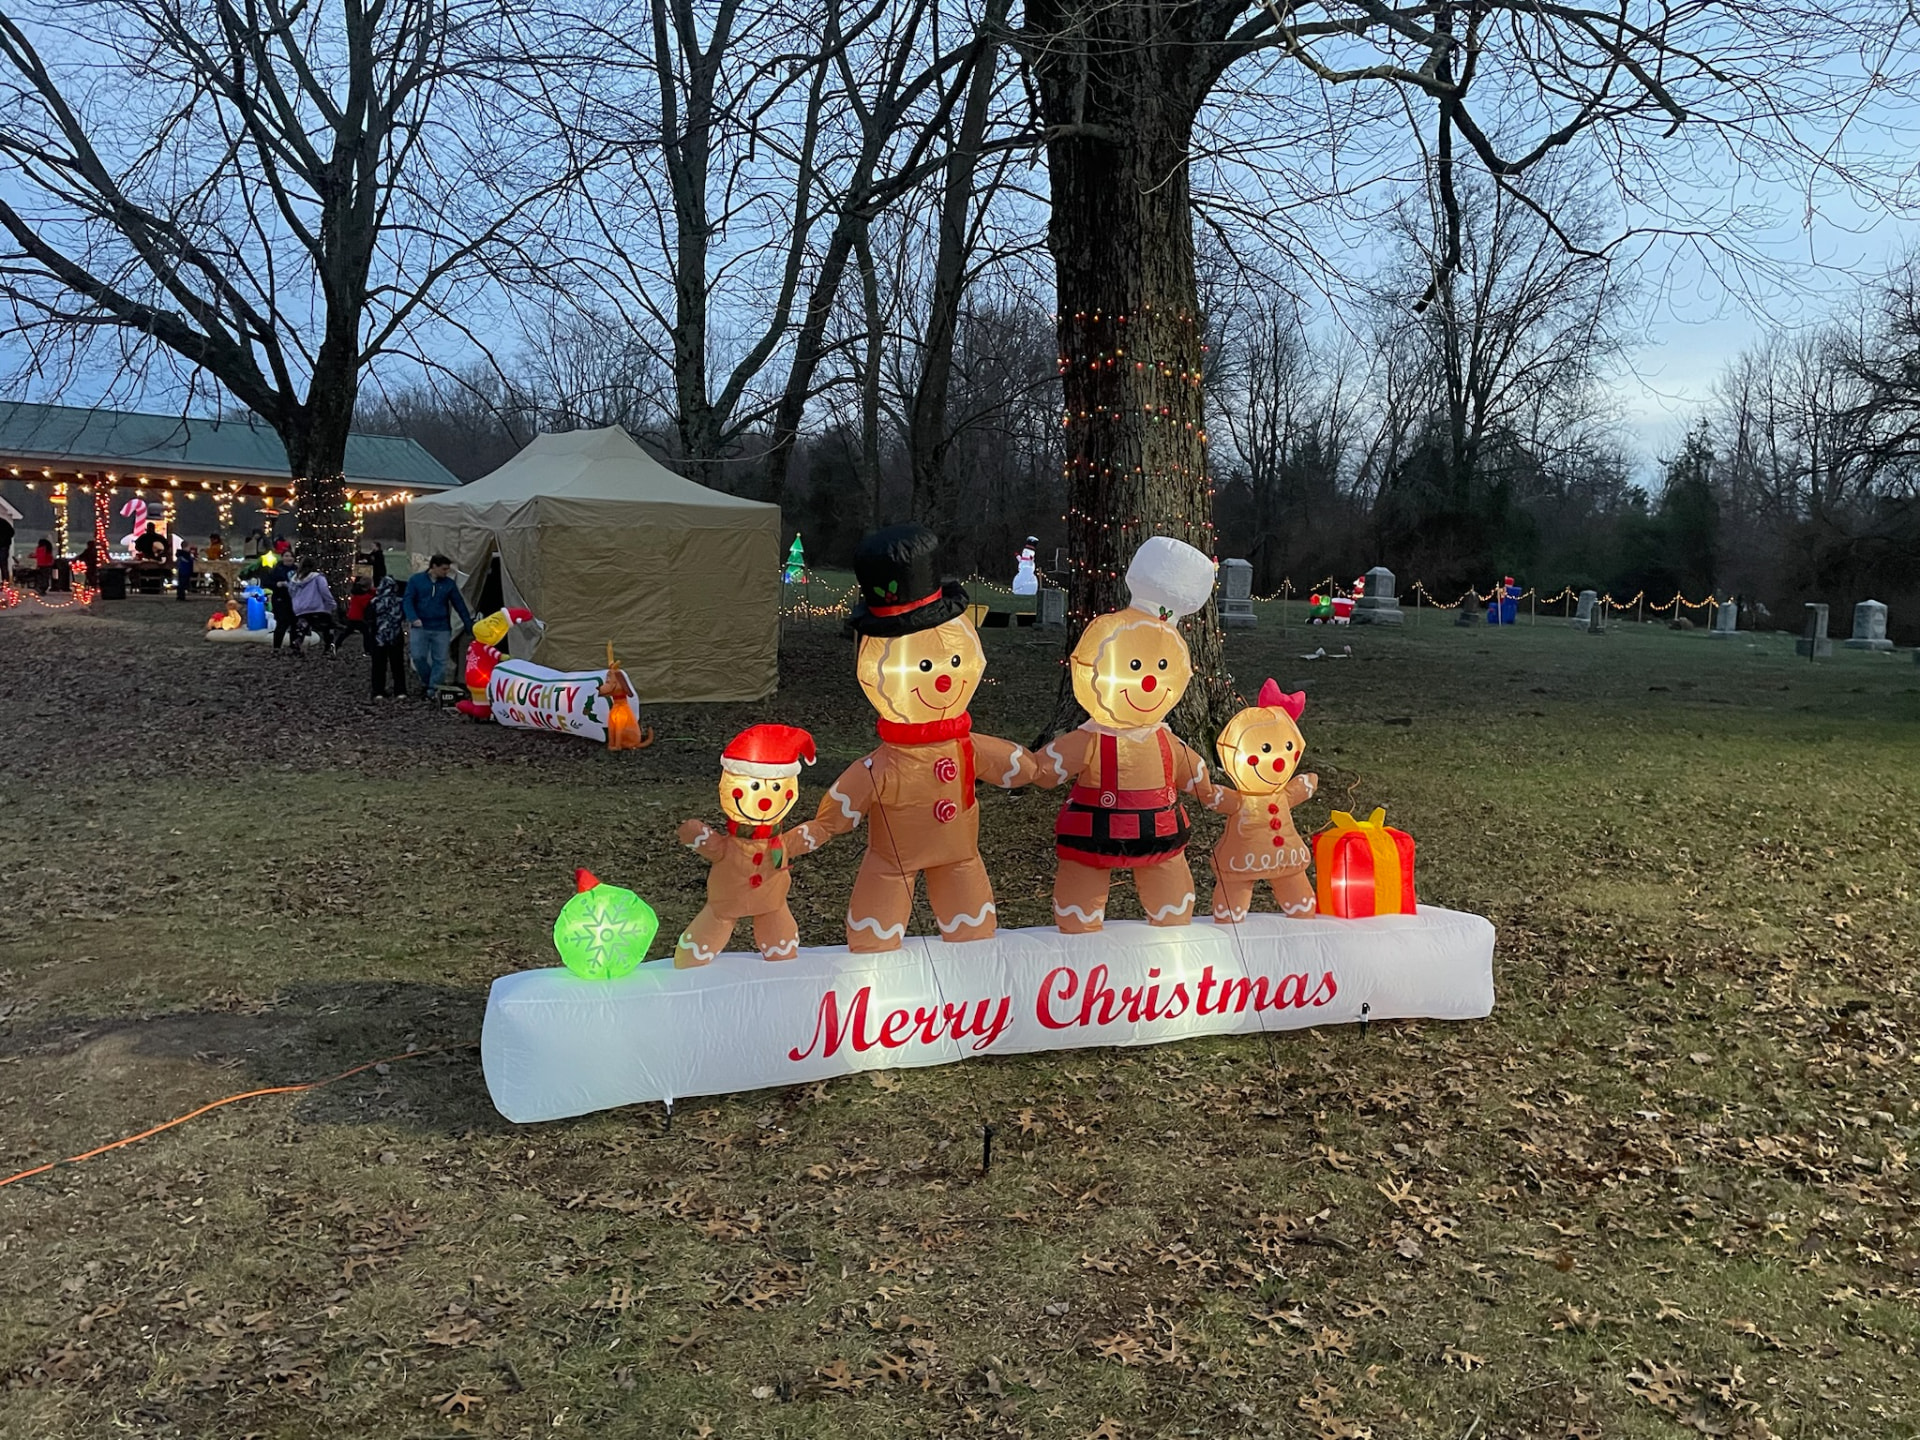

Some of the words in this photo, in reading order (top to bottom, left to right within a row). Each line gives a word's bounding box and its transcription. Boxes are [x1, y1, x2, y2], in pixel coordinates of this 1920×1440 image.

[496, 677, 581, 714] NAUGHTY
[509, 707, 531, 725] OR
[528, 710, 572, 732] NICE
[788, 986, 1014, 1061] Merry
[1036, 964, 1338, 1030] Christmas
